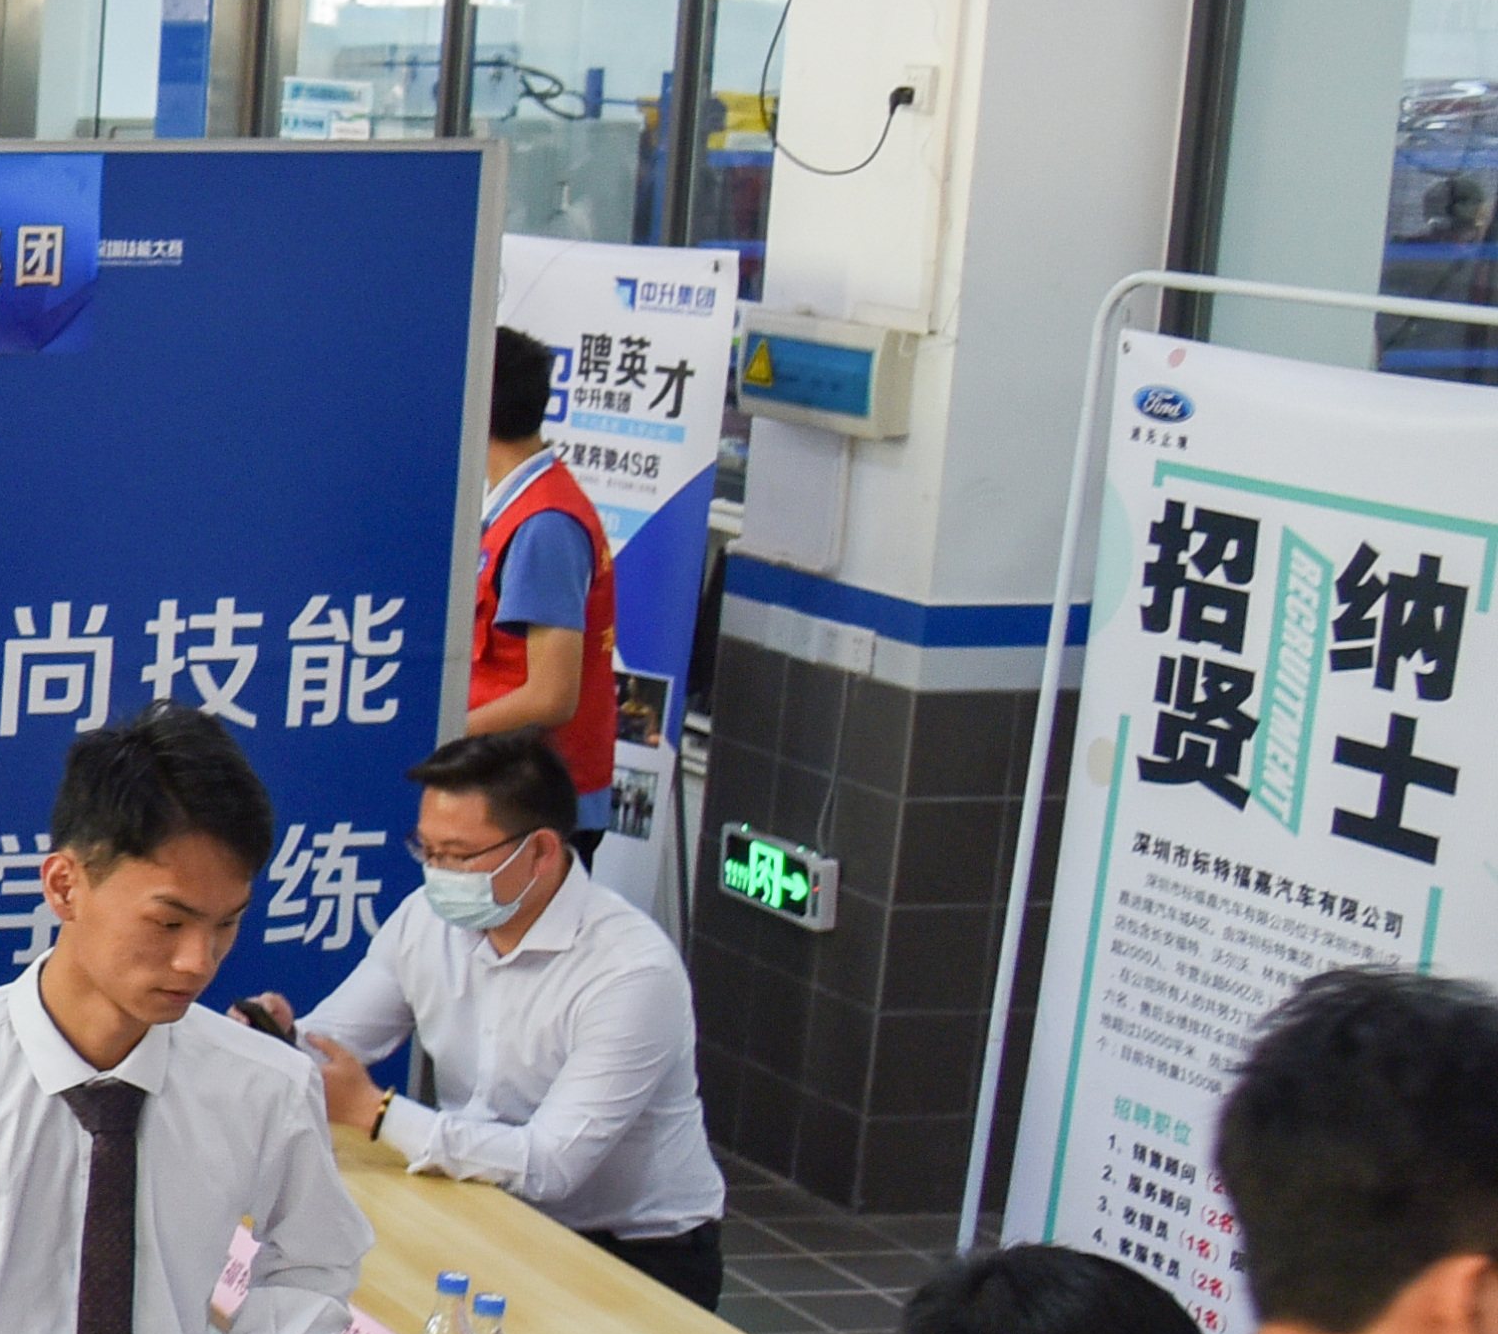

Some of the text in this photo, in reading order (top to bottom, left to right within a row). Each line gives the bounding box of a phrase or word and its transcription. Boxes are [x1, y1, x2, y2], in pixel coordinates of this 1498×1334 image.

[639, 281, 716, 309] 中升集团
[573, 386, 633, 415] 中升集团
[1259, 545, 1324, 823] RECRUITMENT
[1130, 830, 1404, 939] 深圳市标特福嘉汽车有限公司
[1114, 1094, 1193, 1147] 招聘职位
